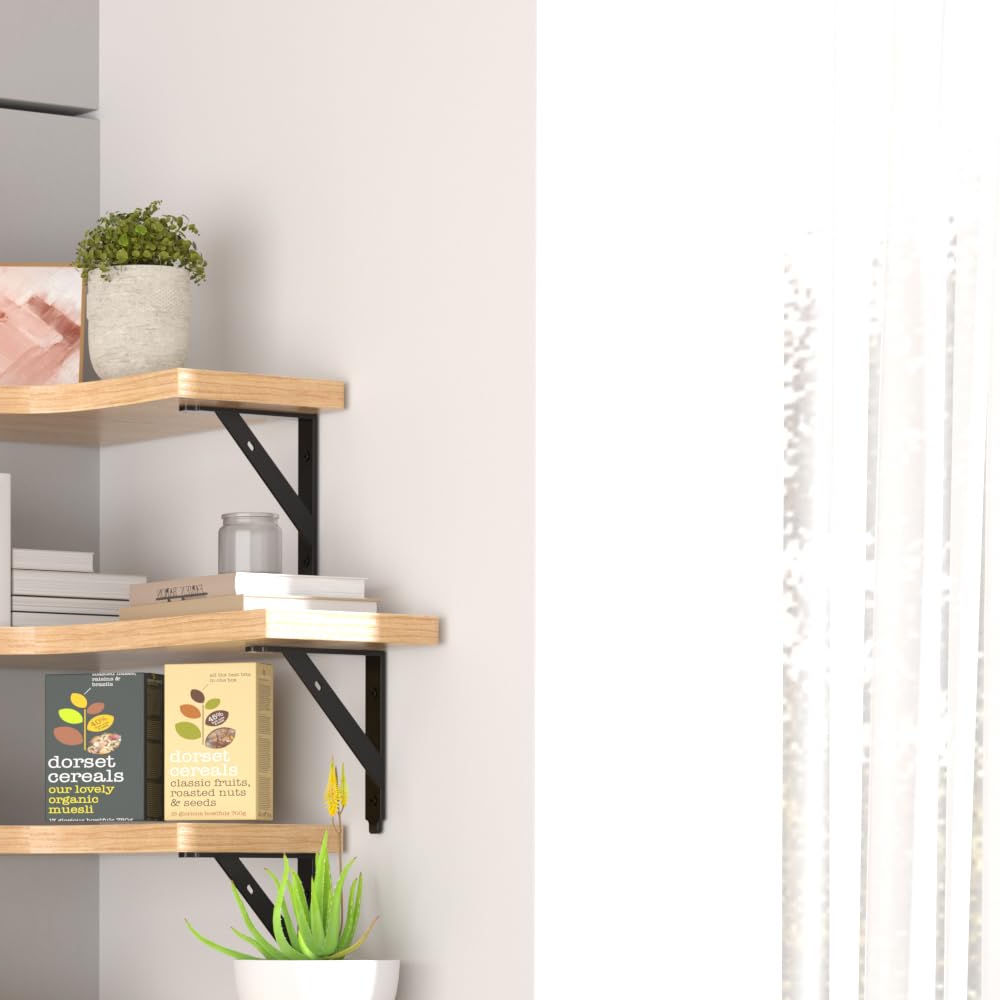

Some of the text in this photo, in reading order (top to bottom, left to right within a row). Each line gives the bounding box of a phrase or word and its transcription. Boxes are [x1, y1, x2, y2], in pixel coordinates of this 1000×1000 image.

[47, 755, 117, 769] dorset
[169, 750, 231, 763] dorset
[47, 769, 125, 783] cereals
[169, 764, 238, 777] cereals
[170, 778, 251, 788] classic fruits,
[48, 784, 115, 796] our lovely
[170, 789, 247, 797] roasted nuts
[48, 794, 99, 806] organic
[170, 798, 217, 807] & seeds
[48, 805, 94, 814] muesli
